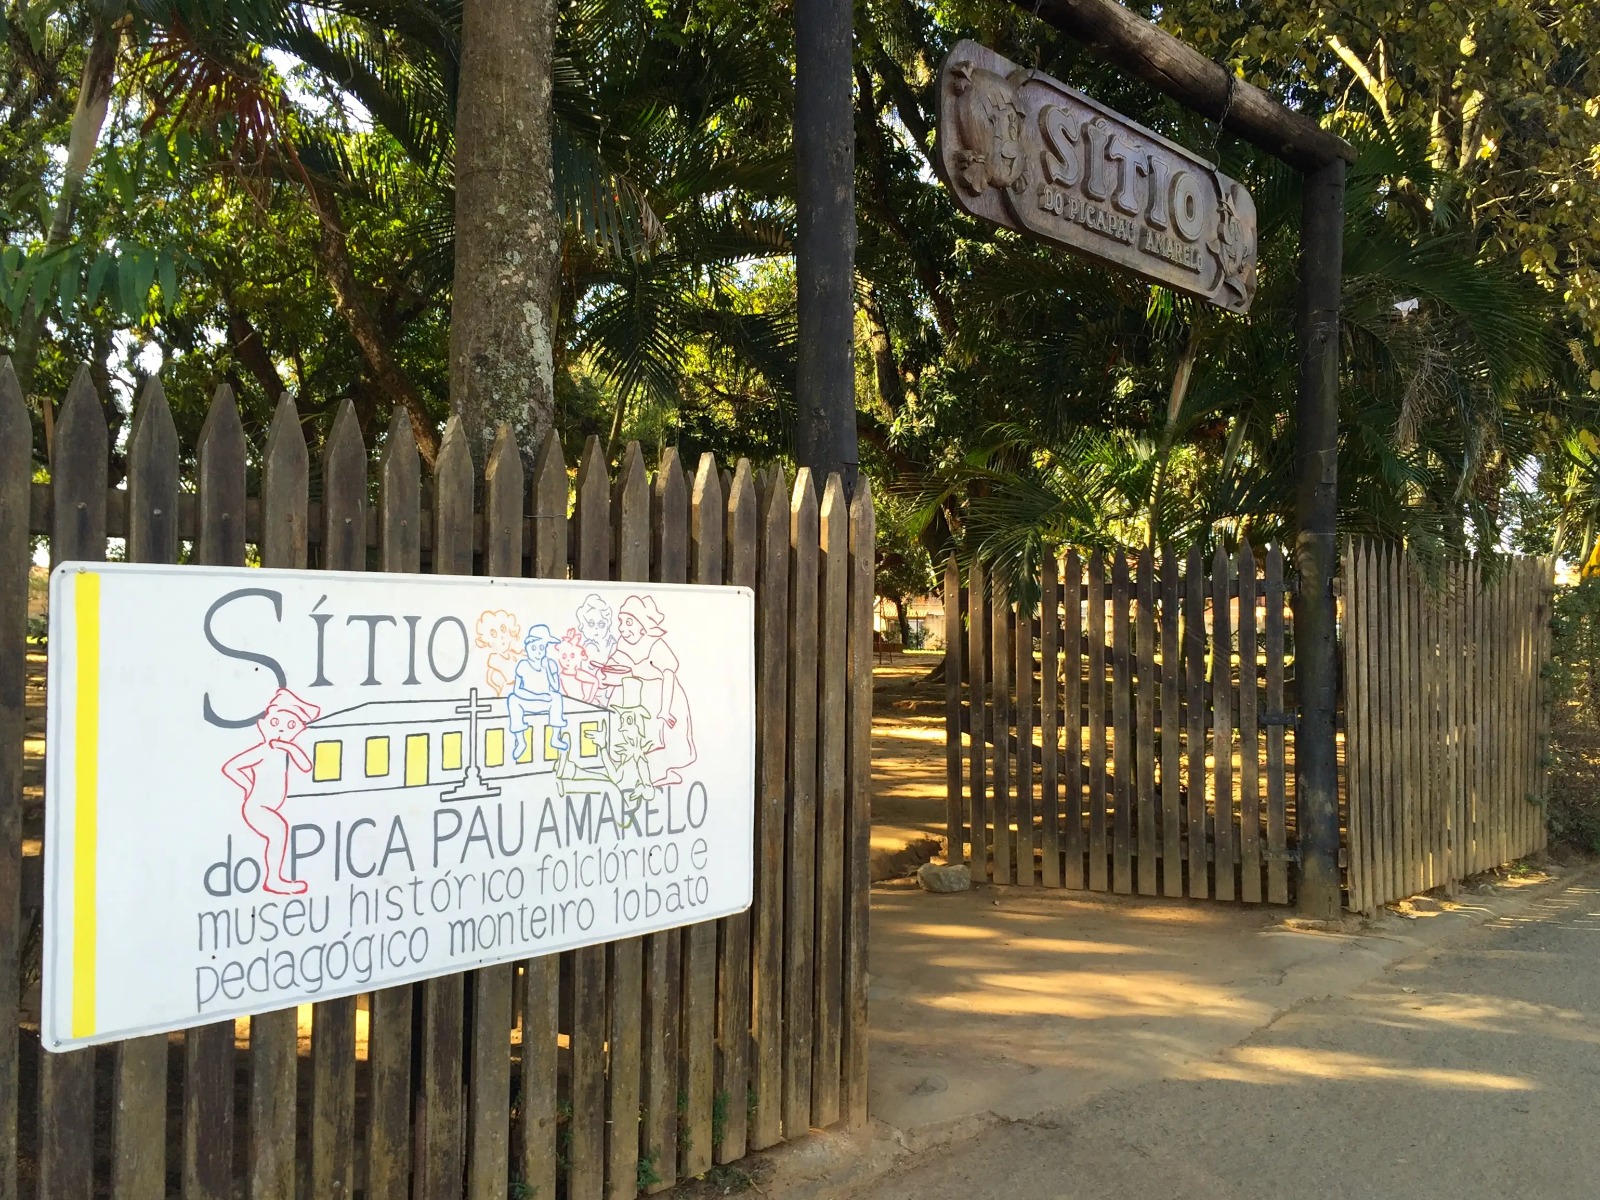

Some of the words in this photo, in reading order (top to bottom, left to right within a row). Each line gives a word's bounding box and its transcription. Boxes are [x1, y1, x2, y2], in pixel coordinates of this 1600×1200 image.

[1042, 185, 1064, 215] DO
[203, 587, 469, 729] SÍTIO
[198, 895, 330, 951] museu
[348, 865, 524, 928] histórico
[537, 842, 679, 895] folclórico
[690, 837, 708, 870] e
[203, 834, 261, 897] do
[290, 817, 415, 882] PICA
[433, 800, 524, 868] PAU
[535, 780, 708, 853] AMARELO
[195, 926, 429, 1014] pedagógico
[448, 897, 595, 957] monteiro
[613, 875, 709, 924] lobato
